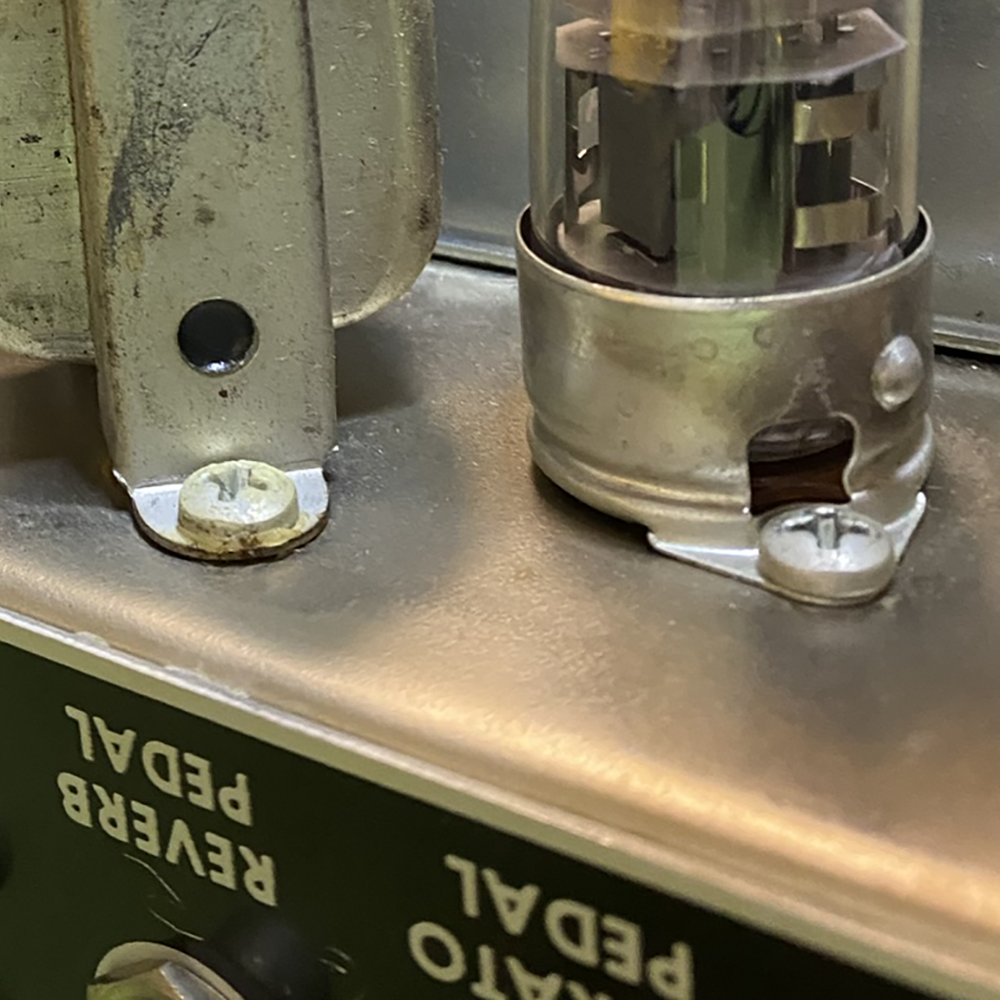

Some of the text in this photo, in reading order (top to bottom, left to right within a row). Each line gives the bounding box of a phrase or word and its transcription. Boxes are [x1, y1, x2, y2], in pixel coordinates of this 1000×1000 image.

[65, 705, 252, 826] PEDAL
[57, 772, 277, 907] REVERB
[444, 854, 695, 1000] PEDAL
